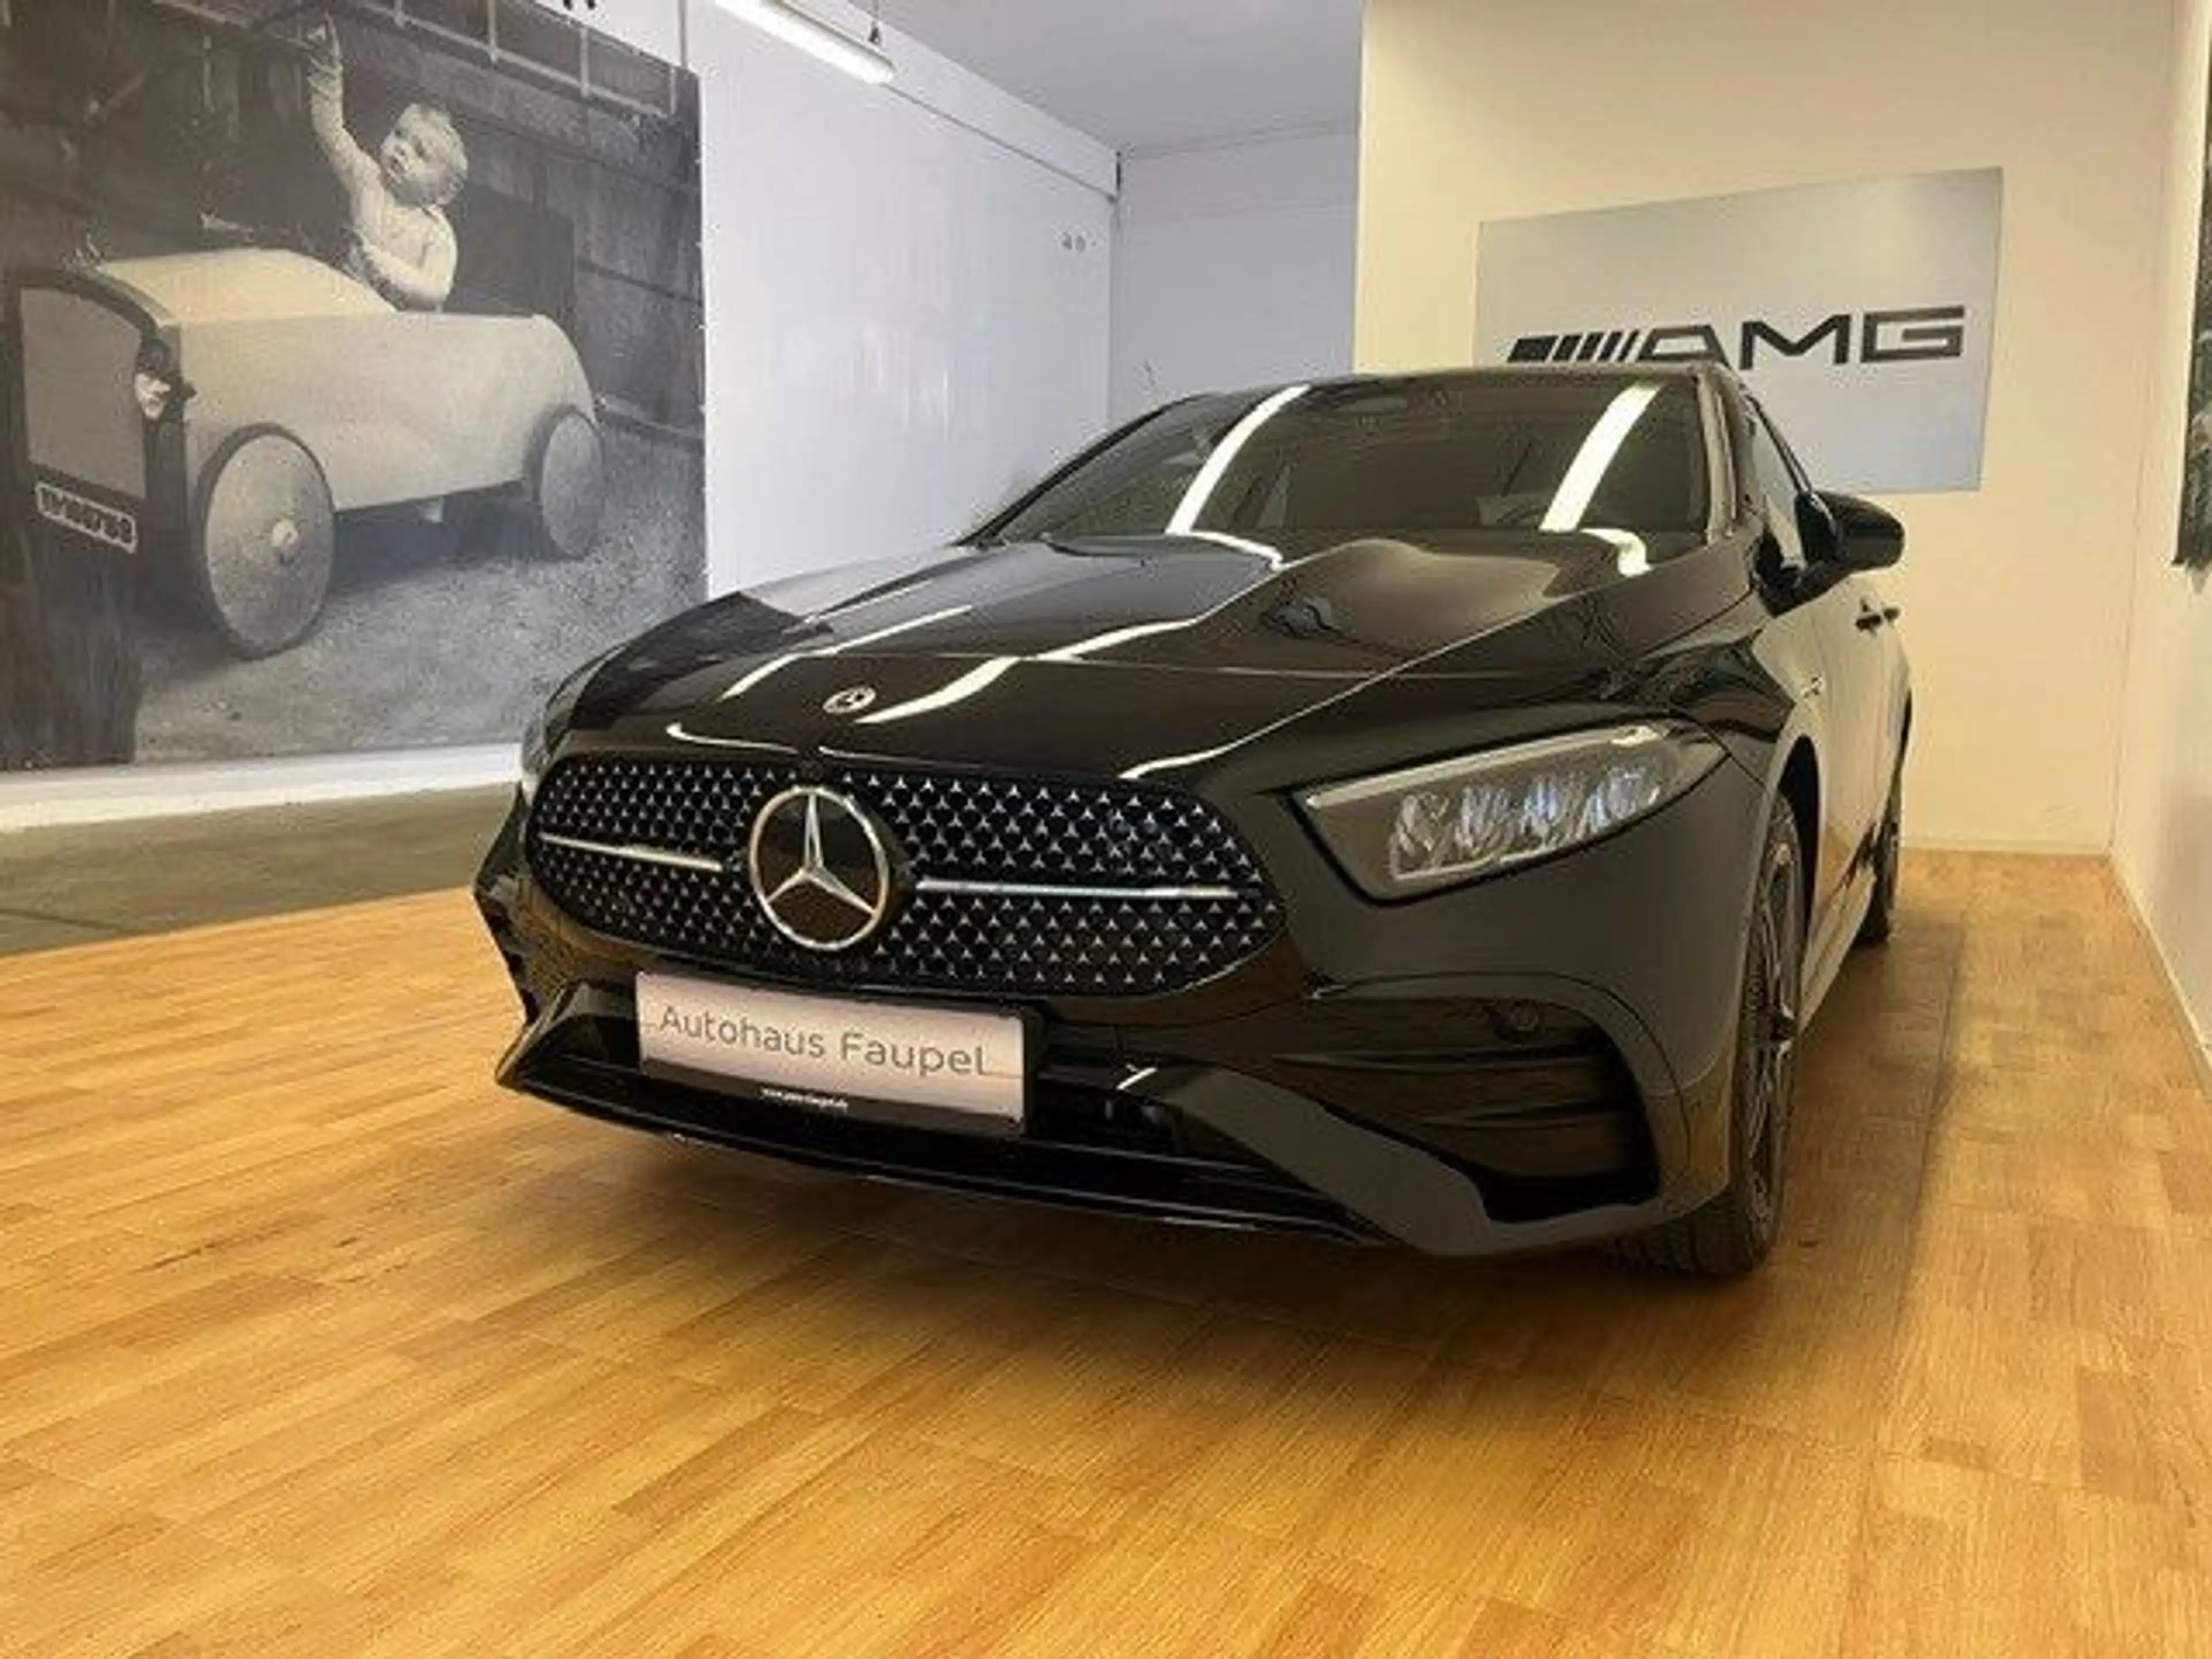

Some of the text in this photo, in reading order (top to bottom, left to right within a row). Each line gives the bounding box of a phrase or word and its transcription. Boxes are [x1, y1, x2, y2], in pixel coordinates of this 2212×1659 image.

[1636, 305, 1965, 370] AMG
[660, 1005, 992, 1077] Autohaus Faupel
